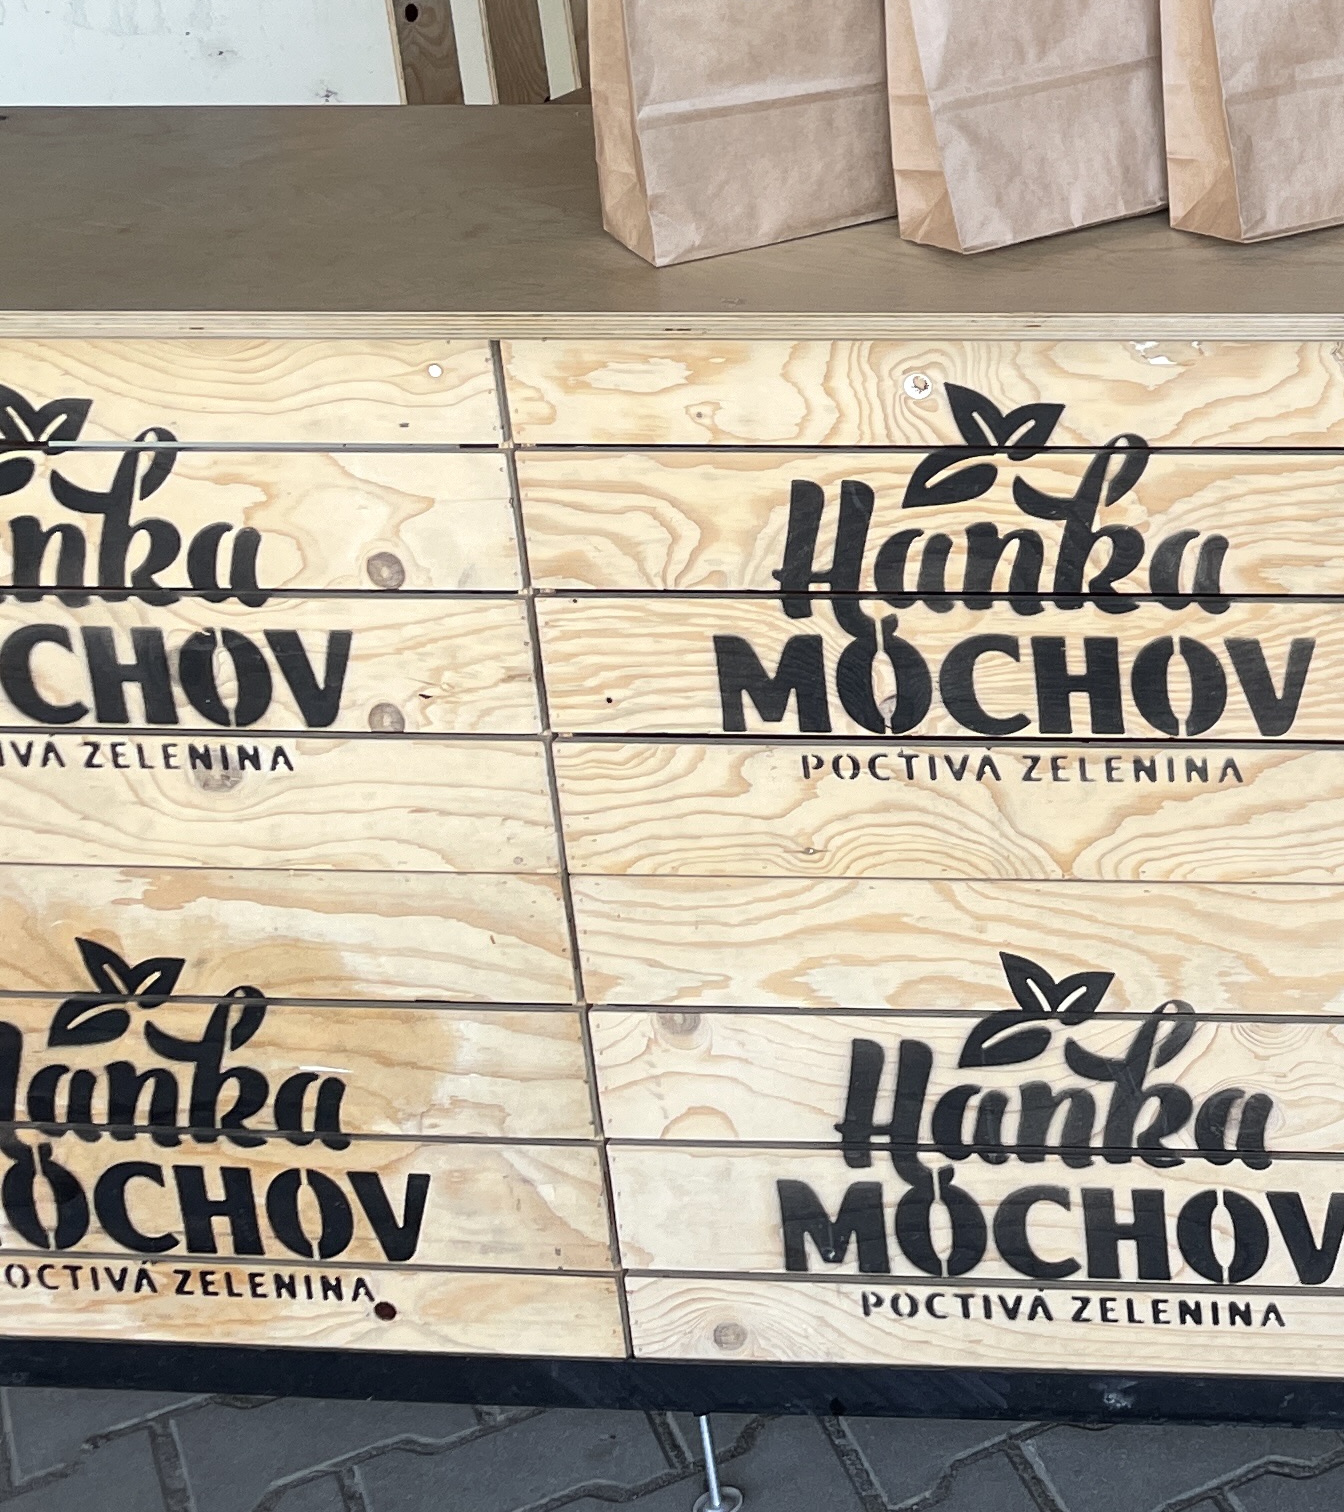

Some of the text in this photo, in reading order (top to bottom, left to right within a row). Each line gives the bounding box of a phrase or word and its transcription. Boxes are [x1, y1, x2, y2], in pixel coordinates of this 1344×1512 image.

[0, 427, 271, 607] nka
[772, 433, 1231, 638] Hanka
[0, 624, 353, 728] CHOV
[713, 633, 1316, 737] MOCHOV
[81, 740, 294, 772] ZELENINA
[1022, 752, 1244, 784] ZELENINA
[834, 999, 1274, 1186] Hanka
[0, 1159, 431, 1262] OCHOV
[5, 1262, 376, 1302] OCTIVÁ ZELENINA
[1070, 1294, 1286, 1328] ZELENINA
